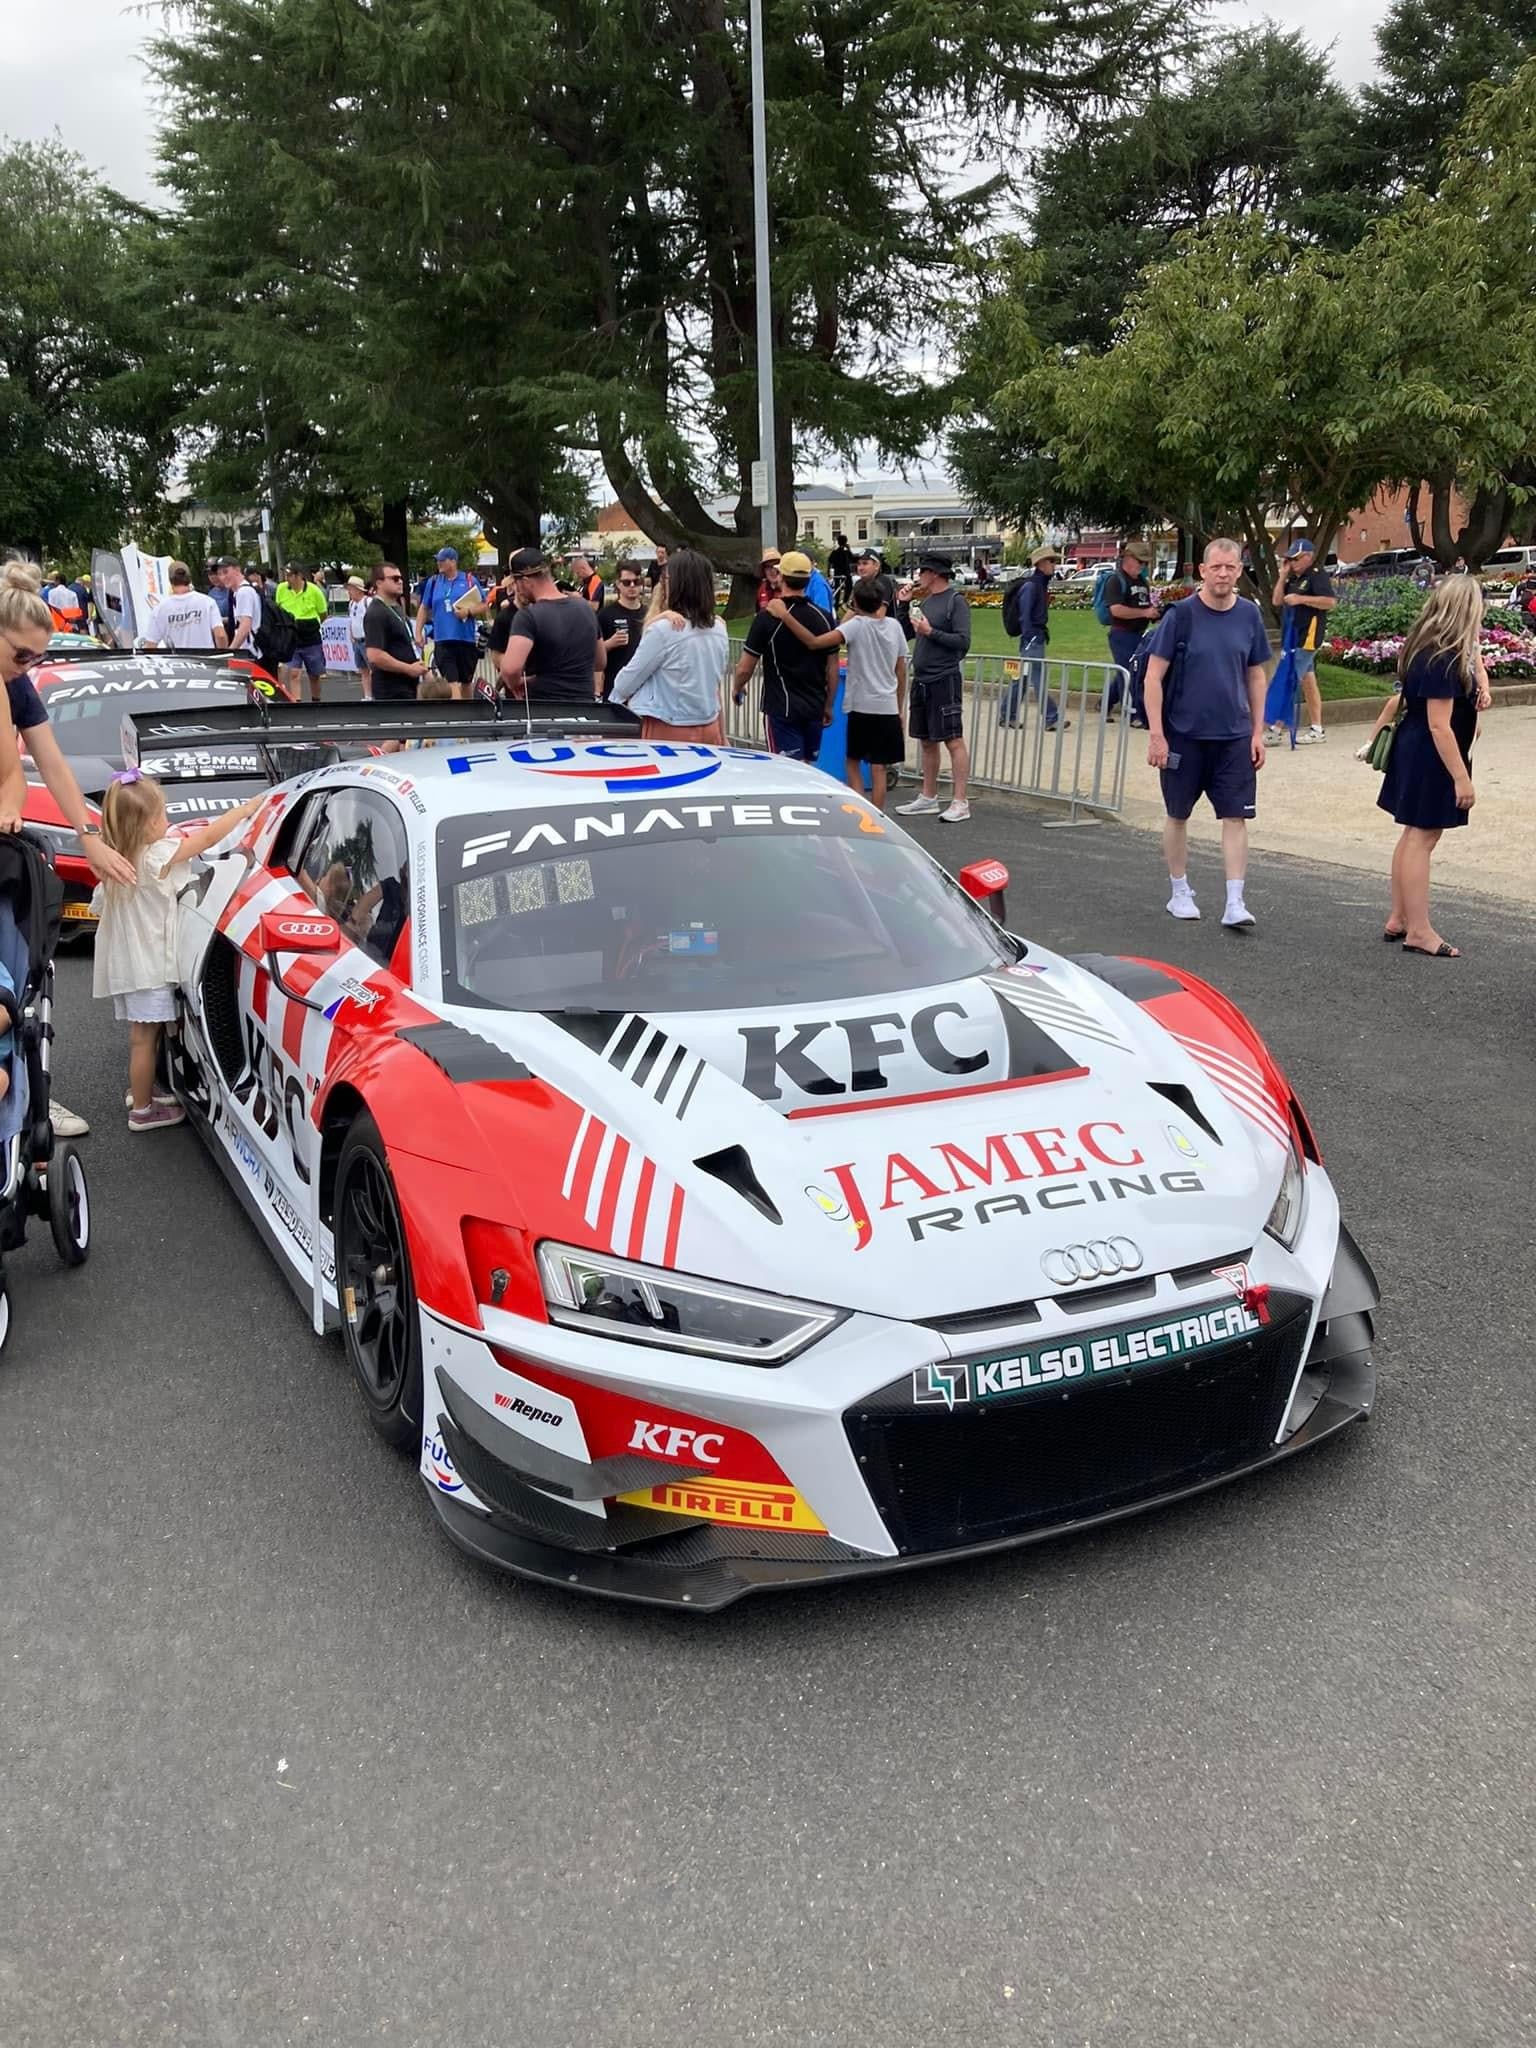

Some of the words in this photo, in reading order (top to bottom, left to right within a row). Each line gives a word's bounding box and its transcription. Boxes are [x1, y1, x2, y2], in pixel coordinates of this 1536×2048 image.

[322, 626, 347, 641] BATHURST
[332, 644, 349, 662] HOUR
[48, 679, 239, 704] FANATEC
[171, 756, 257, 766] TECNAM
[447, 744, 774, 775] FUCHS
[407, 790, 427, 815] FELLER
[842, 804, 885, 834] 2
[462, 805, 822, 868] FANATEC
[416, 885, 430, 948] PERFORMANCE
[738, 1002, 990, 1100] KFC
[825, 1122, 1144, 1252] JAMEC
[907, 1170, 1205, 1242] RACING
[975, 1346, 1084, 1396] KELSO
[1093, 1303, 1260, 1373] ELECTRICAL
[510, 1397, 563, 1426] Repco
[628, 1420, 725, 1464] KFC
[652, 1480, 796, 1522] PIRELLI
